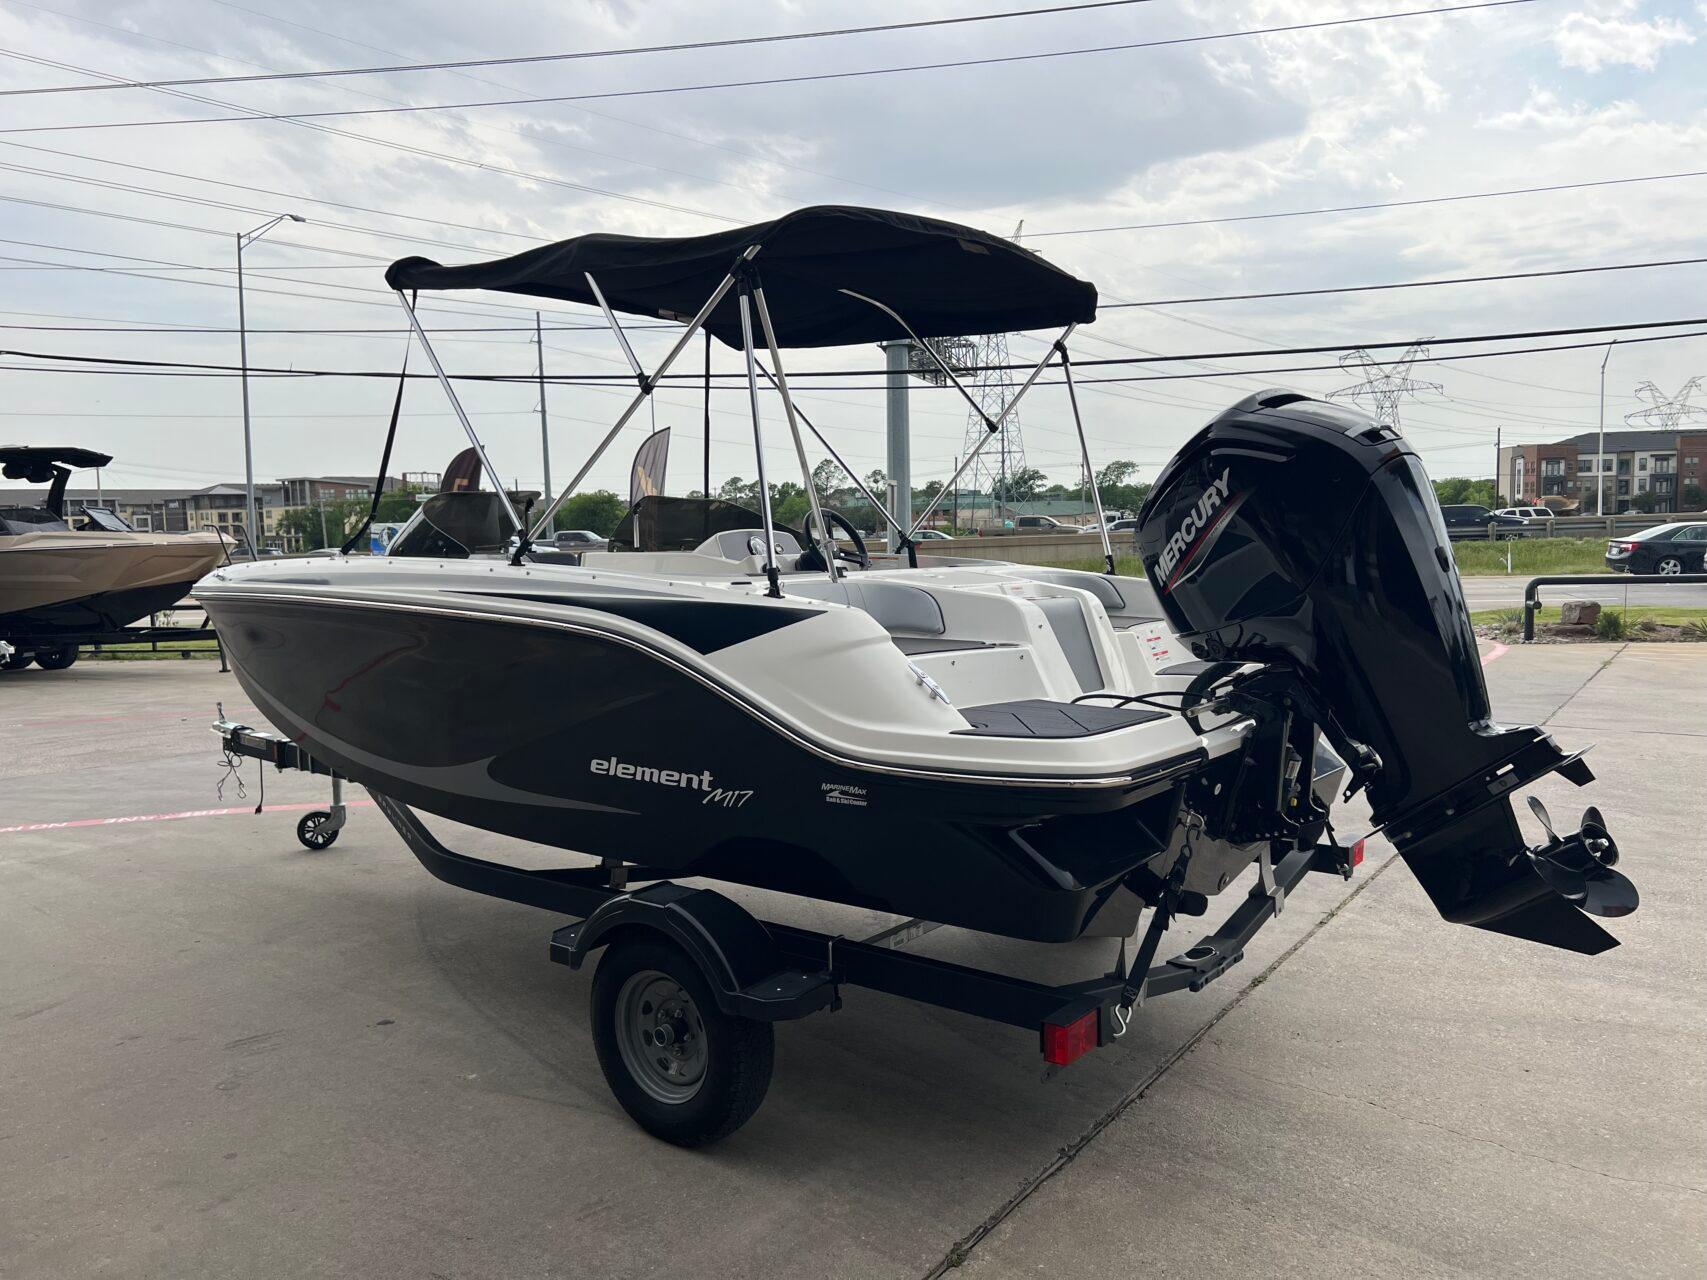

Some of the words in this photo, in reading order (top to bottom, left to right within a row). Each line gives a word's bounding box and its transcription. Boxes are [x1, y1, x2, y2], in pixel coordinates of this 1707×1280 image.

[1153, 467, 1229, 587] MERCURY
[590, 756, 714, 791] element
[702, 788, 754, 808] M17
